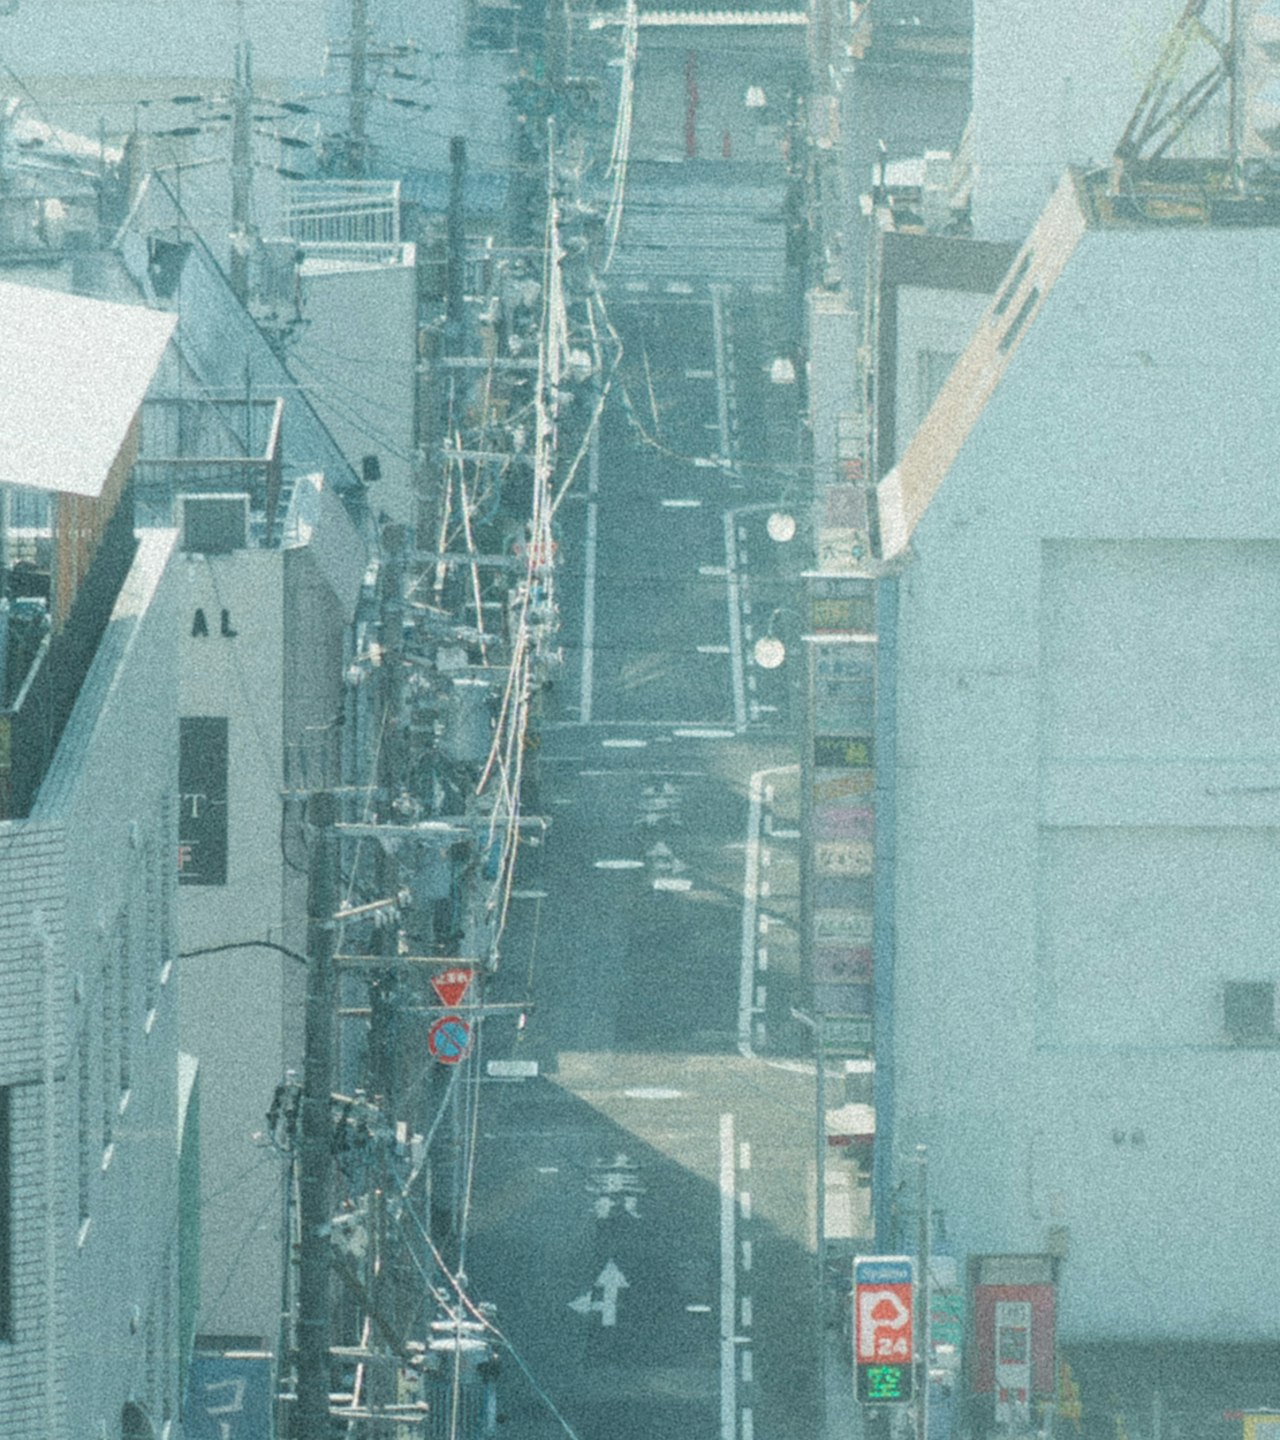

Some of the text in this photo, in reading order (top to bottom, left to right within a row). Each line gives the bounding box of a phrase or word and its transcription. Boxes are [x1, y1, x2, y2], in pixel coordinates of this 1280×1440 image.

[860, 1291, 908, 1357] P
[878, 1338, 908, 1356] 24
[867, 1366, 902, 1398] 空
